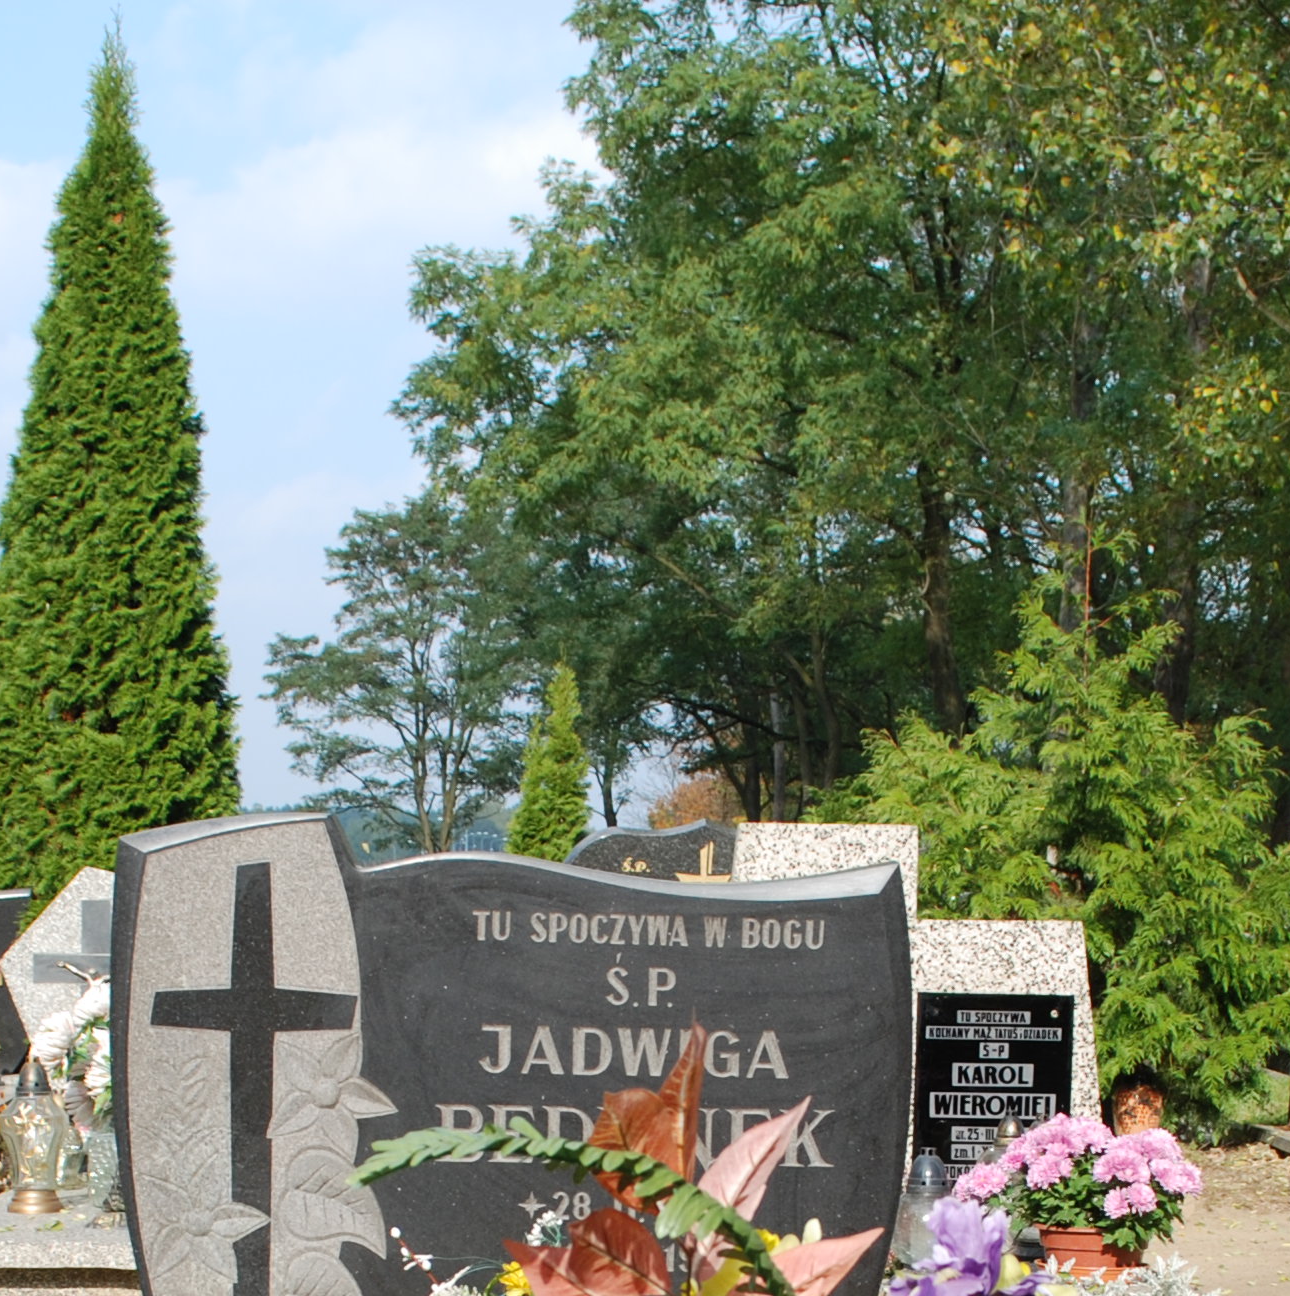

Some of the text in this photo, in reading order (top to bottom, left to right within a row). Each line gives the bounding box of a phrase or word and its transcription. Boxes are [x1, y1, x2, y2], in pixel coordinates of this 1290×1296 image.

[473, 910, 825, 950] TU SPOCZYWA W BOGU
[960, 1012, 1026, 1023] TU SPOCZYWA
[478, 1024, 789, 1080] JADWGA
[958, 1065, 1029, 1085] KAROL
